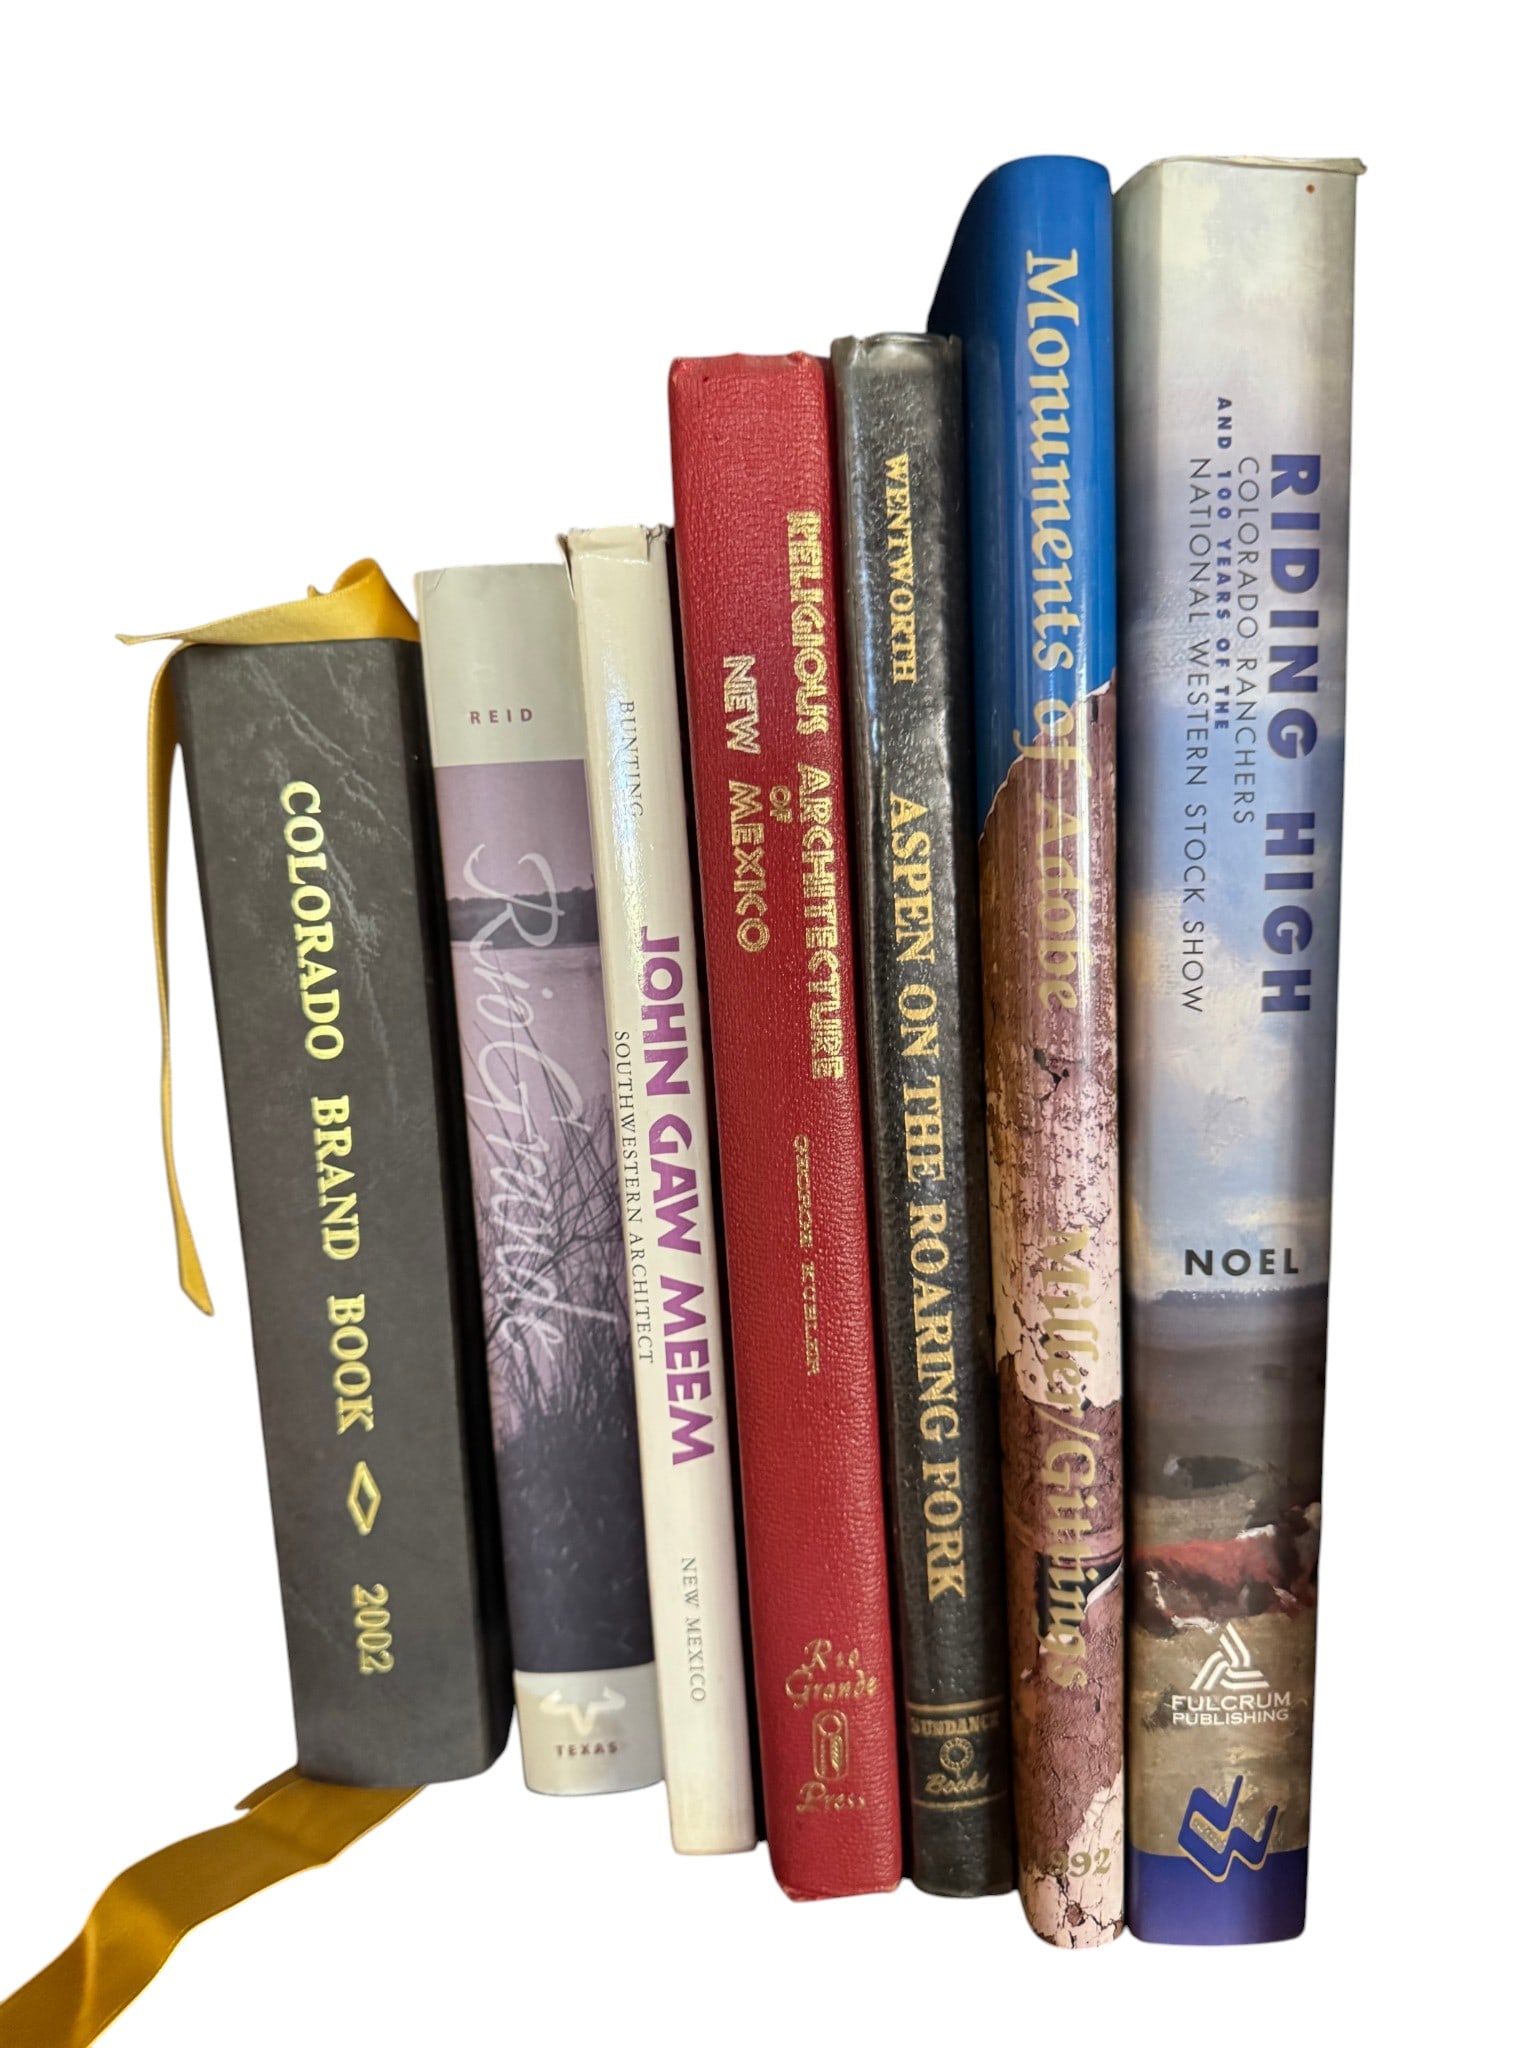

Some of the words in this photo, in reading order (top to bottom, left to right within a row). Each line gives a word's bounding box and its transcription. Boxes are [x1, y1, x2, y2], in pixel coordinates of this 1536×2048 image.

[1025, 248, 1080, 671] Monuments
[1216, 397, 1232, 450] AND
[1186, 458, 1212, 623] NATIONAL
[1216, 470, 1232, 520] 100
[1236, 456, 1260, 640] COLORADO
[786, 510, 830, 738] RELIGIOUS
[884, 452, 918, 685] WENTWORTH
[1215, 538, 1232, 620] YEARS
[1267, 453, 1321, 761] RIDING
[723, 654, 762, 755] NEW
[1213, 686, 1230, 731] THE
[1215, 638, 1231, 670] OF
[469, 707, 534, 725] REID
[620, 700, 644, 818] BUNTING
[1012, 698, 1092, 783] of
[1185, 639, 1210, 787] WESTERN
[1233, 658, 1257, 824] RANCHERS
[769, 785, 793, 825] OF
[1183, 804, 1207, 904] STOCK
[279, 780, 345, 1060] COLORADO
[728, 779, 771, 954] MEXICO
[797, 762, 845, 1081] ARCHITECTURE
[889, 794, 936, 965] ASPEN
[1034, 792, 1092, 1012] Adobe
[1261, 811, 1316, 1013] HIGH
[463, 843, 566, 1029] Rio
[1181, 921, 1206, 1014] SHOW
[638, 925, 692, 1095] JOHN
[897, 983, 940, 1059] ON
[310, 1094, 361, 1261] BRAND
[647, 1113, 702, 1256] GAW
[902, 1075, 945, 1184] THE
[464, 1041, 618, 1361] Grande
[613, 1030, 642, 1224] SOUTHWESTERN
[628, 1232, 655, 1365] ARCHITECT
[1183, 1247, 1300, 1276] NOEL
[325, 1293, 374, 1435] BOOK
[659, 1274, 715, 1467] MEEM
[908, 1198, 961, 1443] ROARING
[680, 1556, 699, 1608] NEW
[921, 1460, 968, 1602] FORK
[350, 1583, 395, 1676] 2002
[684, 1617, 706, 1703] MEXICO
[801, 1638, 859, 1672] Rio
[785, 1668, 878, 1710] Grande
[911, 1711, 1000, 1737] SUNDANCE
[1171, 1691, 1291, 1712] FULCRUM
[1172, 1708, 1290, 1726] PUBLISHING
[555, 1740, 619, 1758] TEXAS
[796, 1781, 865, 1813] Press
[925, 1770, 990, 1796] Books
